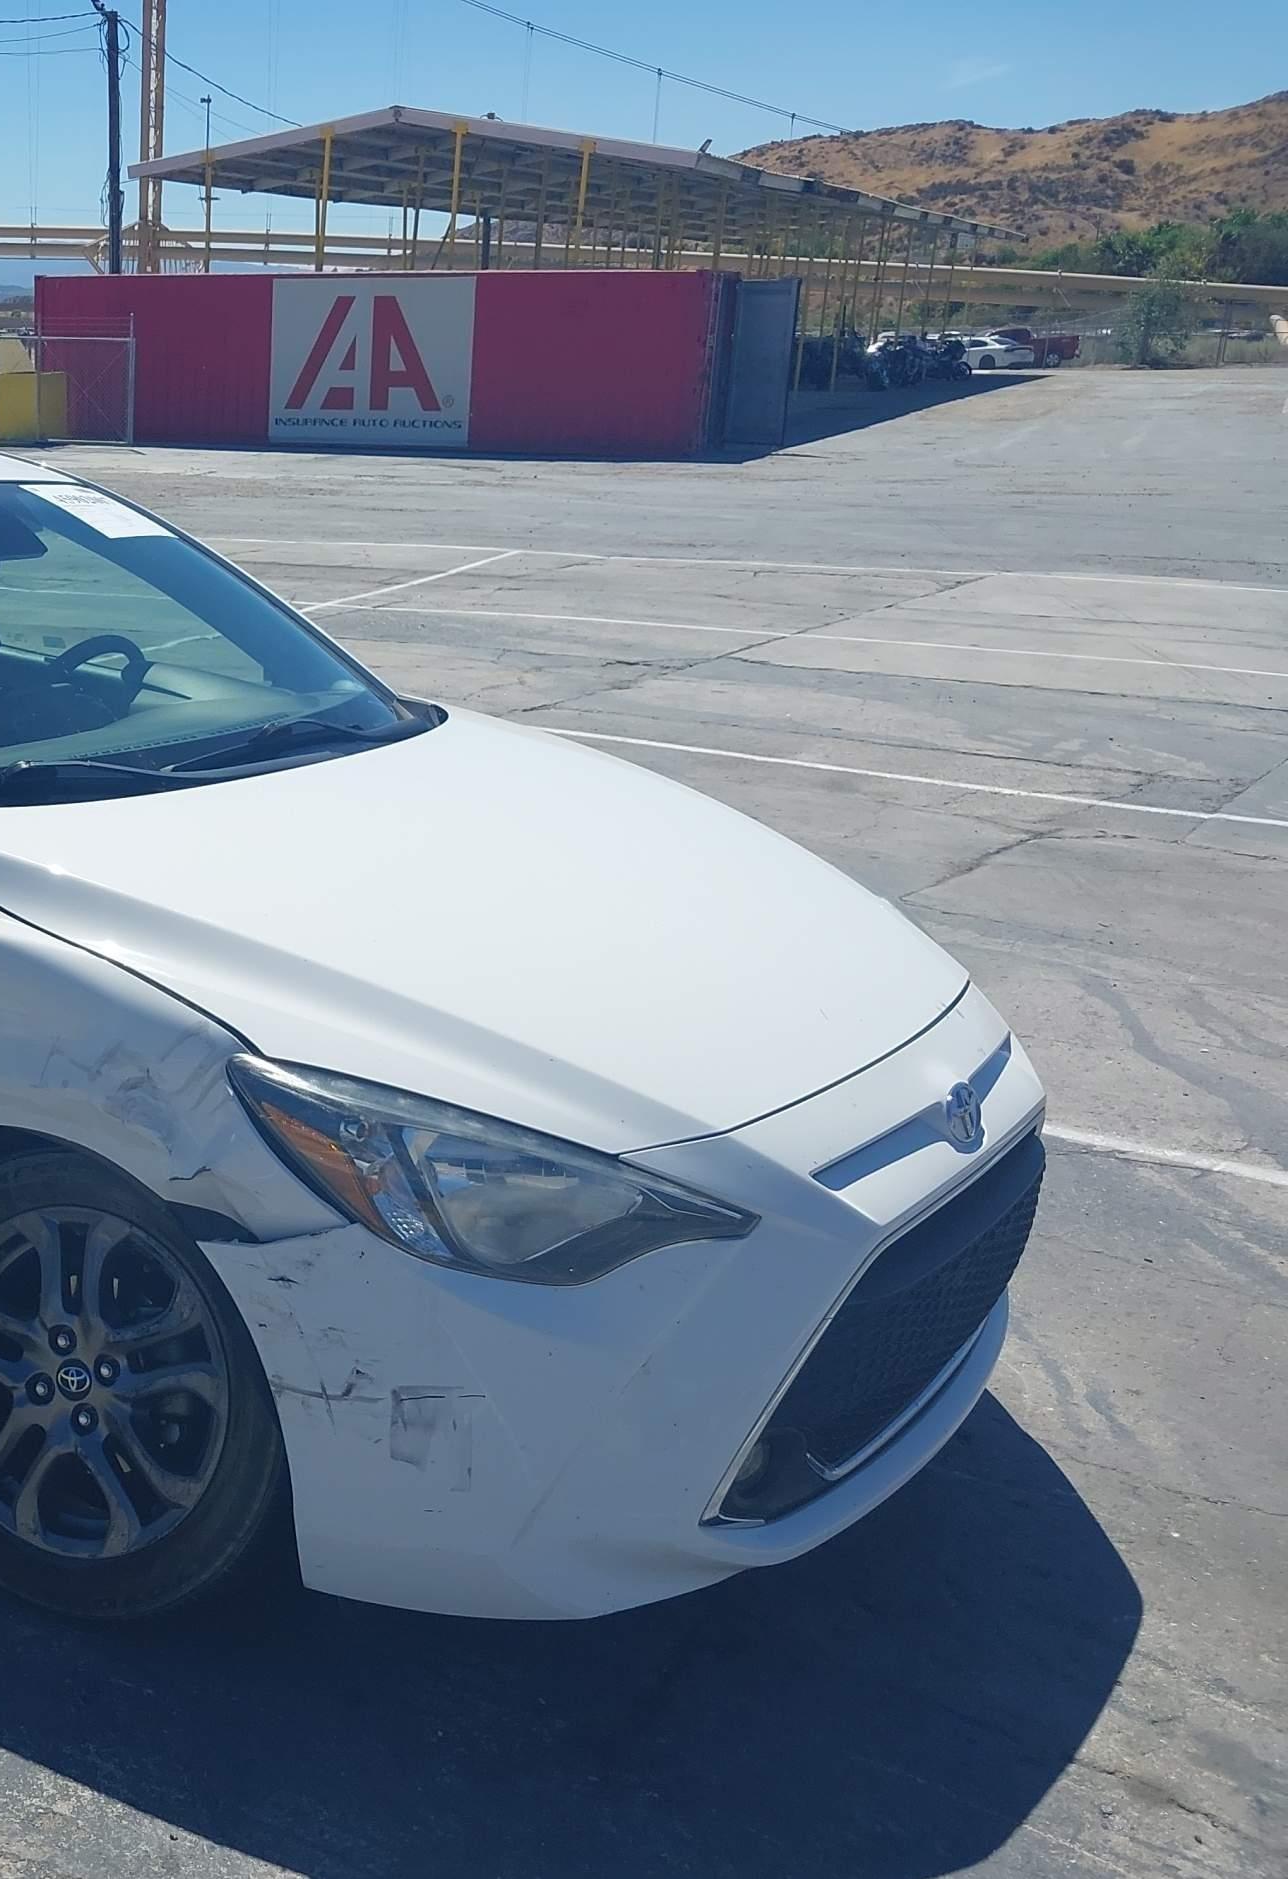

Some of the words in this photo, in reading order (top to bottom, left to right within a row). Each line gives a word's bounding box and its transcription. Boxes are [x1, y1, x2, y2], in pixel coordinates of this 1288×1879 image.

[274, 417, 348, 427] INSURANCE
[352, 418, 390, 428] AUTO
[393, 419, 463, 429] AUCTIONS
